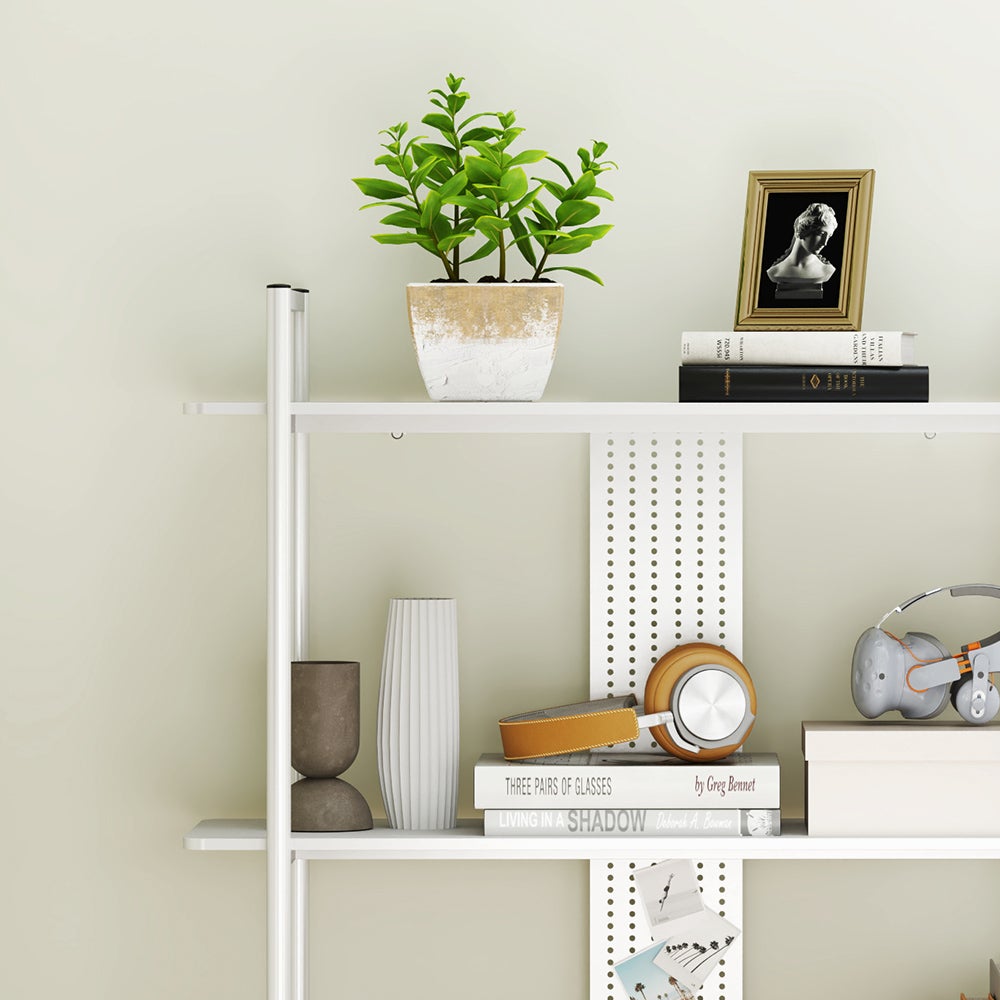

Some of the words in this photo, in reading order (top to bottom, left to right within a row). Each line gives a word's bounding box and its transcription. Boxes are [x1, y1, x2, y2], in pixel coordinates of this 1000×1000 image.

[505, 777, 532, 796] THREE
[534, 777, 559, 796] PAIRS
[561, 777, 572, 796] OF
[574, 777, 612, 796] GLASSES
[695, 775, 705, 797] by
[706, 775, 726, 797] Greg
[728, 775, 756, 793] Bennet
[500, 811, 538, 828] LIVING
[541, 811, 552, 828] IN
[555, 811, 565, 828] A
[567, 809, 647, 833] SHADOW
